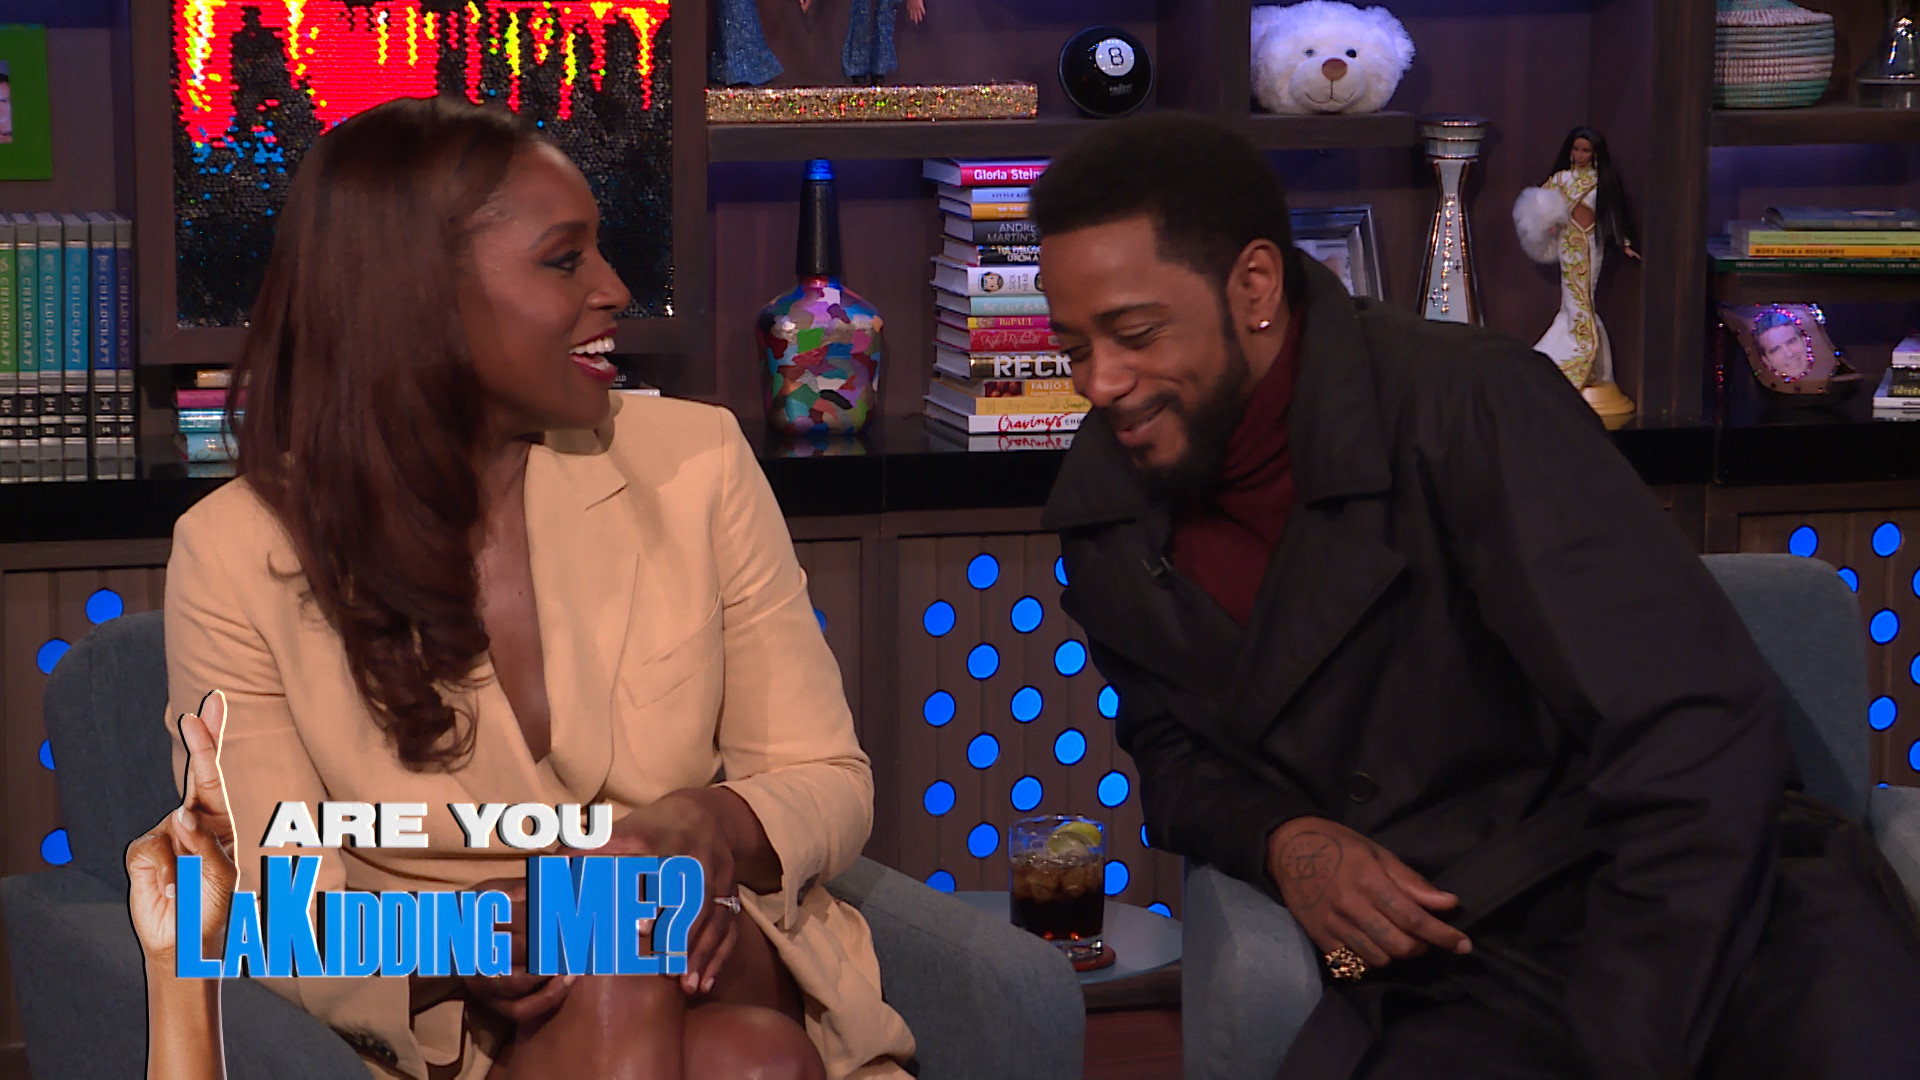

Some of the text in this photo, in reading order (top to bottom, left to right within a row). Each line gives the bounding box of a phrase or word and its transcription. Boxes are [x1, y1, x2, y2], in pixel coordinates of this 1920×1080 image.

[1108, 47, 1124, 66] 8
[973, 168, 1007, 181] Gloria
[71, 275, 81, 364] CHILDCRAFT
[98, 275, 110, 364] CHILDCRAFT
[999, 317, 1034, 326] RuPAUL
[997, 412, 1069, 433] Cravings
